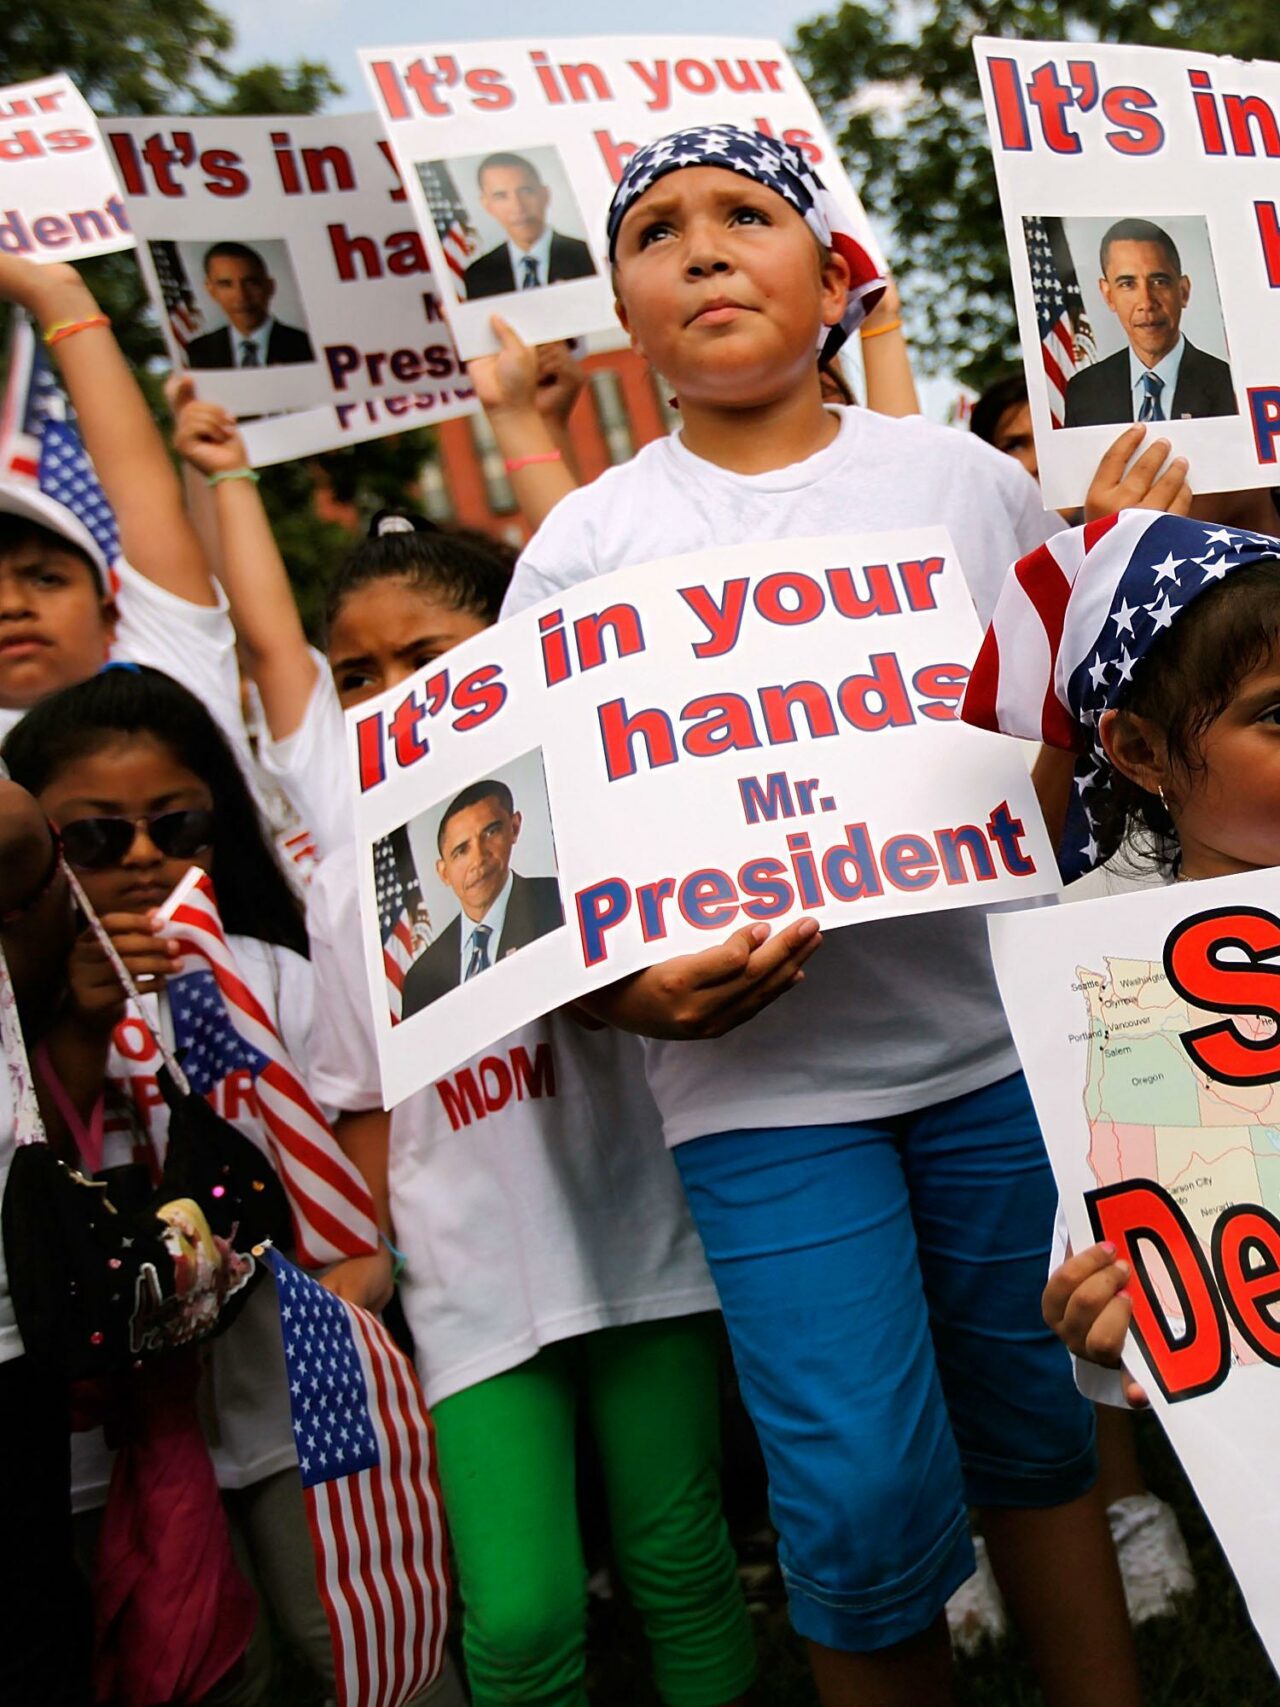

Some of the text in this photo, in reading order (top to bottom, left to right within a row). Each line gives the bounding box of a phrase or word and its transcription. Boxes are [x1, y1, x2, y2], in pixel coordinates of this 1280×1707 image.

[371, 50, 786, 121] It's in your
[985, 56, 1165, 156] It's
[107, 131, 250, 199] It's
[270, 131, 358, 196] in
[355, 556, 946, 794] It's in your
[597, 652, 972, 782] hands
[737, 771, 836, 825] Mr.
[575, 800, 1038, 969] President
[1071, 980, 1100, 992] Seattle
[1119, 973, 1166, 989] Washingto
[1068, 1030, 1102, 1043] Portland
[1108, 1016, 1151, 1032] Vancouver
[1104, 1046, 1132, 1058] Salem
[435, 1043, 557, 1133] MOM
[1131, 1073, 1164, 1087] Oregon
[1196, 1176, 1213, 1190] City
